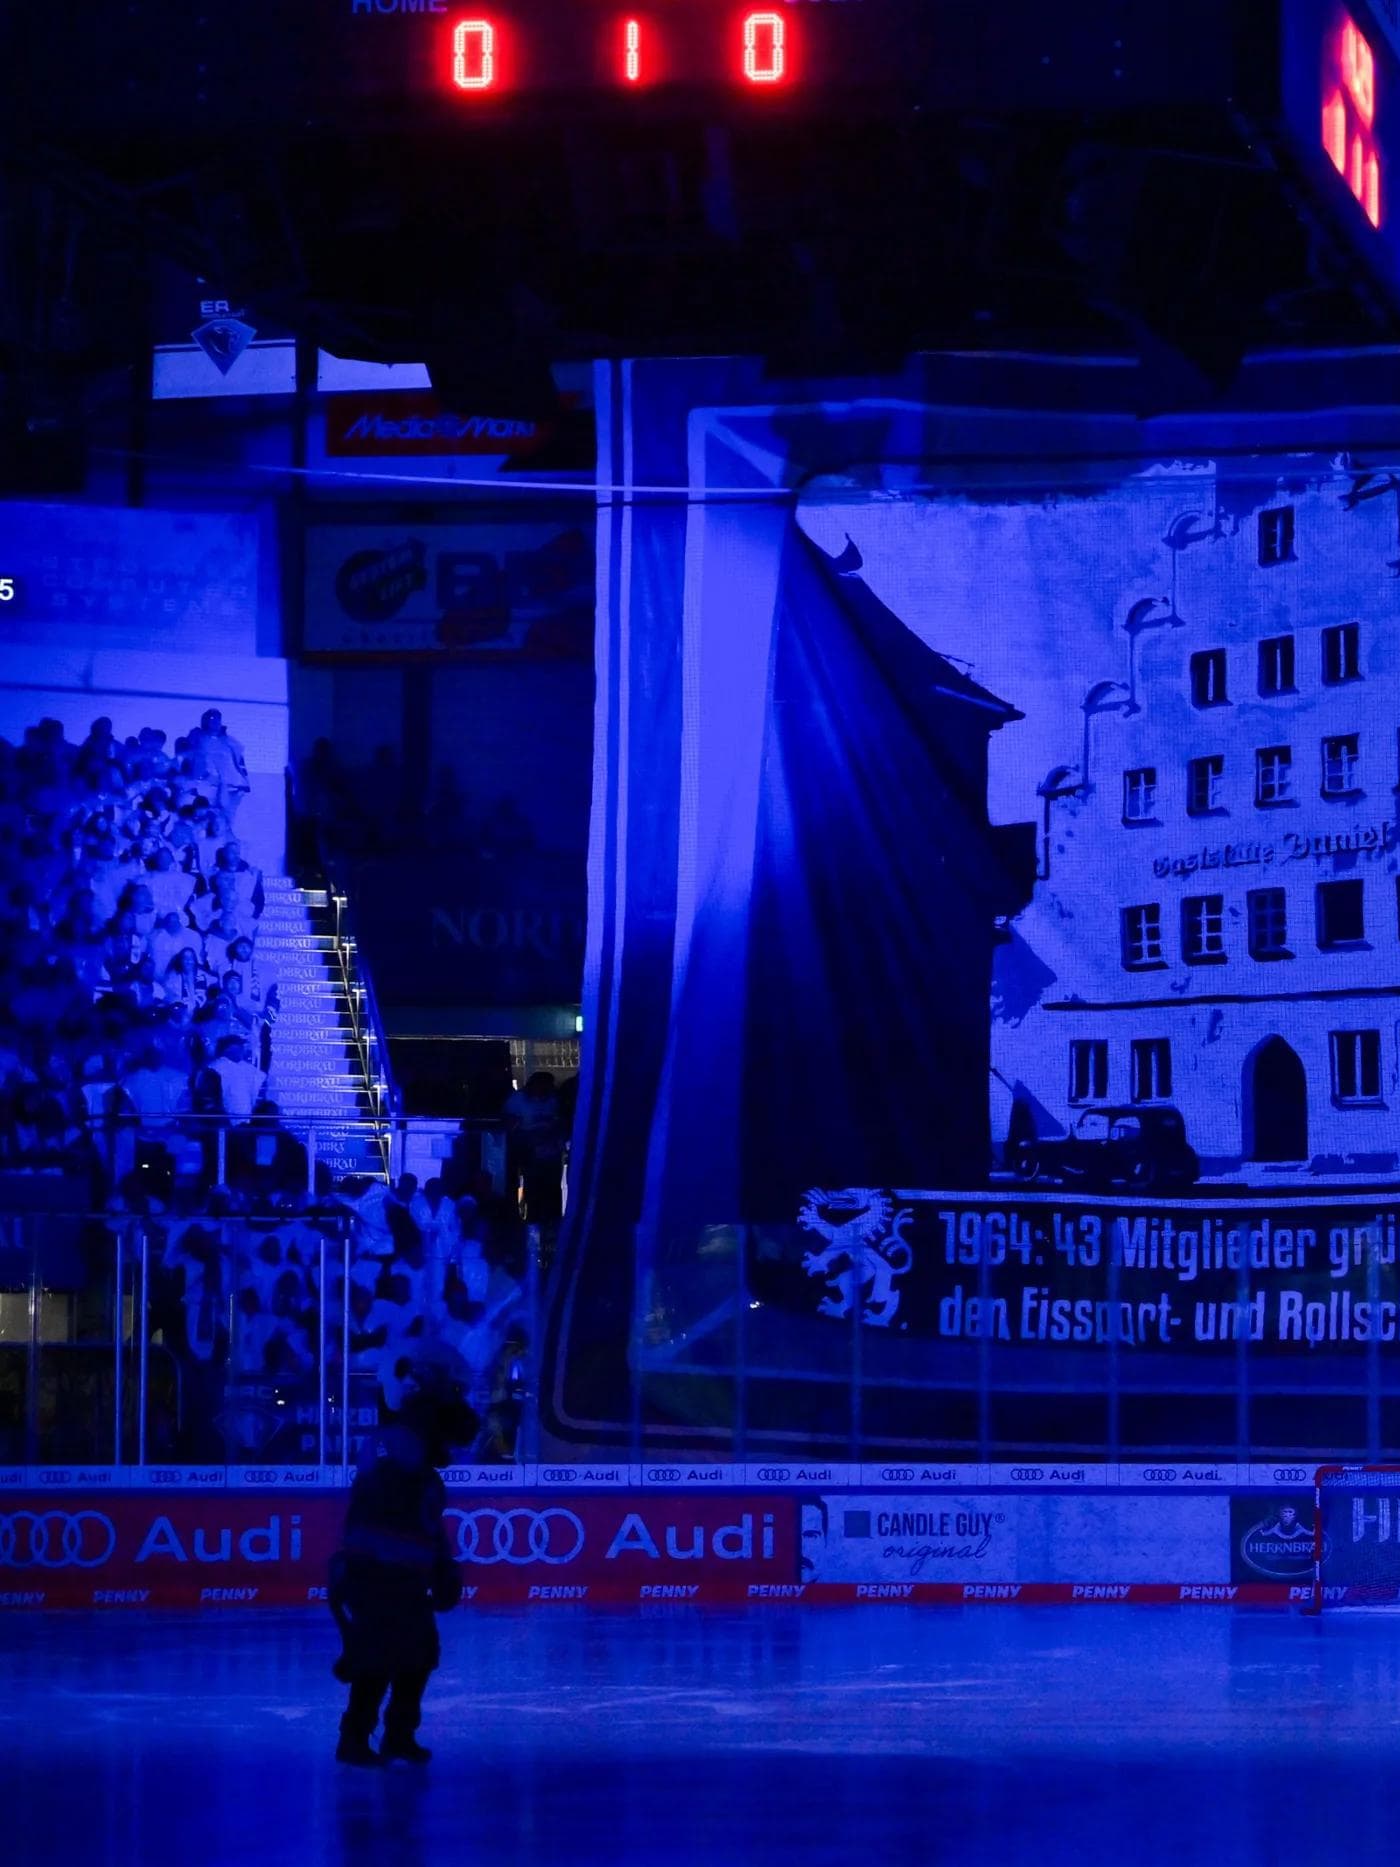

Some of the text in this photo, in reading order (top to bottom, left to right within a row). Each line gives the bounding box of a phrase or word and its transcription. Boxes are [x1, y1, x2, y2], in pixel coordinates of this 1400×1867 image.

[454, 13, 784, 88] 0 1 0
[938, 1210, 1044, 1266] 1964:
[1053, 1210, 1102, 1266] 43
[1118, 1213, 1317, 1282] Mitglieder
[938, 1285, 1010, 1342] den
[1019, 1288, 1182, 1345] Eissport-
[1194, 1290, 1266, 1342] und
[77, 1470, 112, 1484] Audi
[187, 1470, 223, 1484] Audi
[283, 1470, 320, 1484] Audi
[476, 1469, 514, 1483] Audi
[582, 1469, 620, 1482] Audi
[686, 1469, 724, 1482] Audi
[795, 1469, 832, 1482] Audi
[920, 1469, 957, 1482] Audi
[1048, 1469, 1085, 1482] Audi
[1181, 1469, 1218, 1482] Audi
[876, 1512, 950, 1537] CANDLE
[136, 1515, 303, 1563] Audi
[605, 1513, 776, 1560] Audi
[881, 1535, 993, 1576] original
[0, 1591, 46, 1606] ENNY
[93, 1589, 151, 1605] PENNY
[200, 1587, 259, 1602] PENNY
[527, 1585, 588, 1600] PENNY
[639, 1584, 700, 1599] PENNY
[747, 1584, 806, 1599] PENNY
[855, 1584, 913, 1599] PENNY
[962, 1584, 1019, 1599] PENNY
[1071, 1584, 1128, 1599] PENNY
[1179, 1585, 1236, 1600] PENNY
